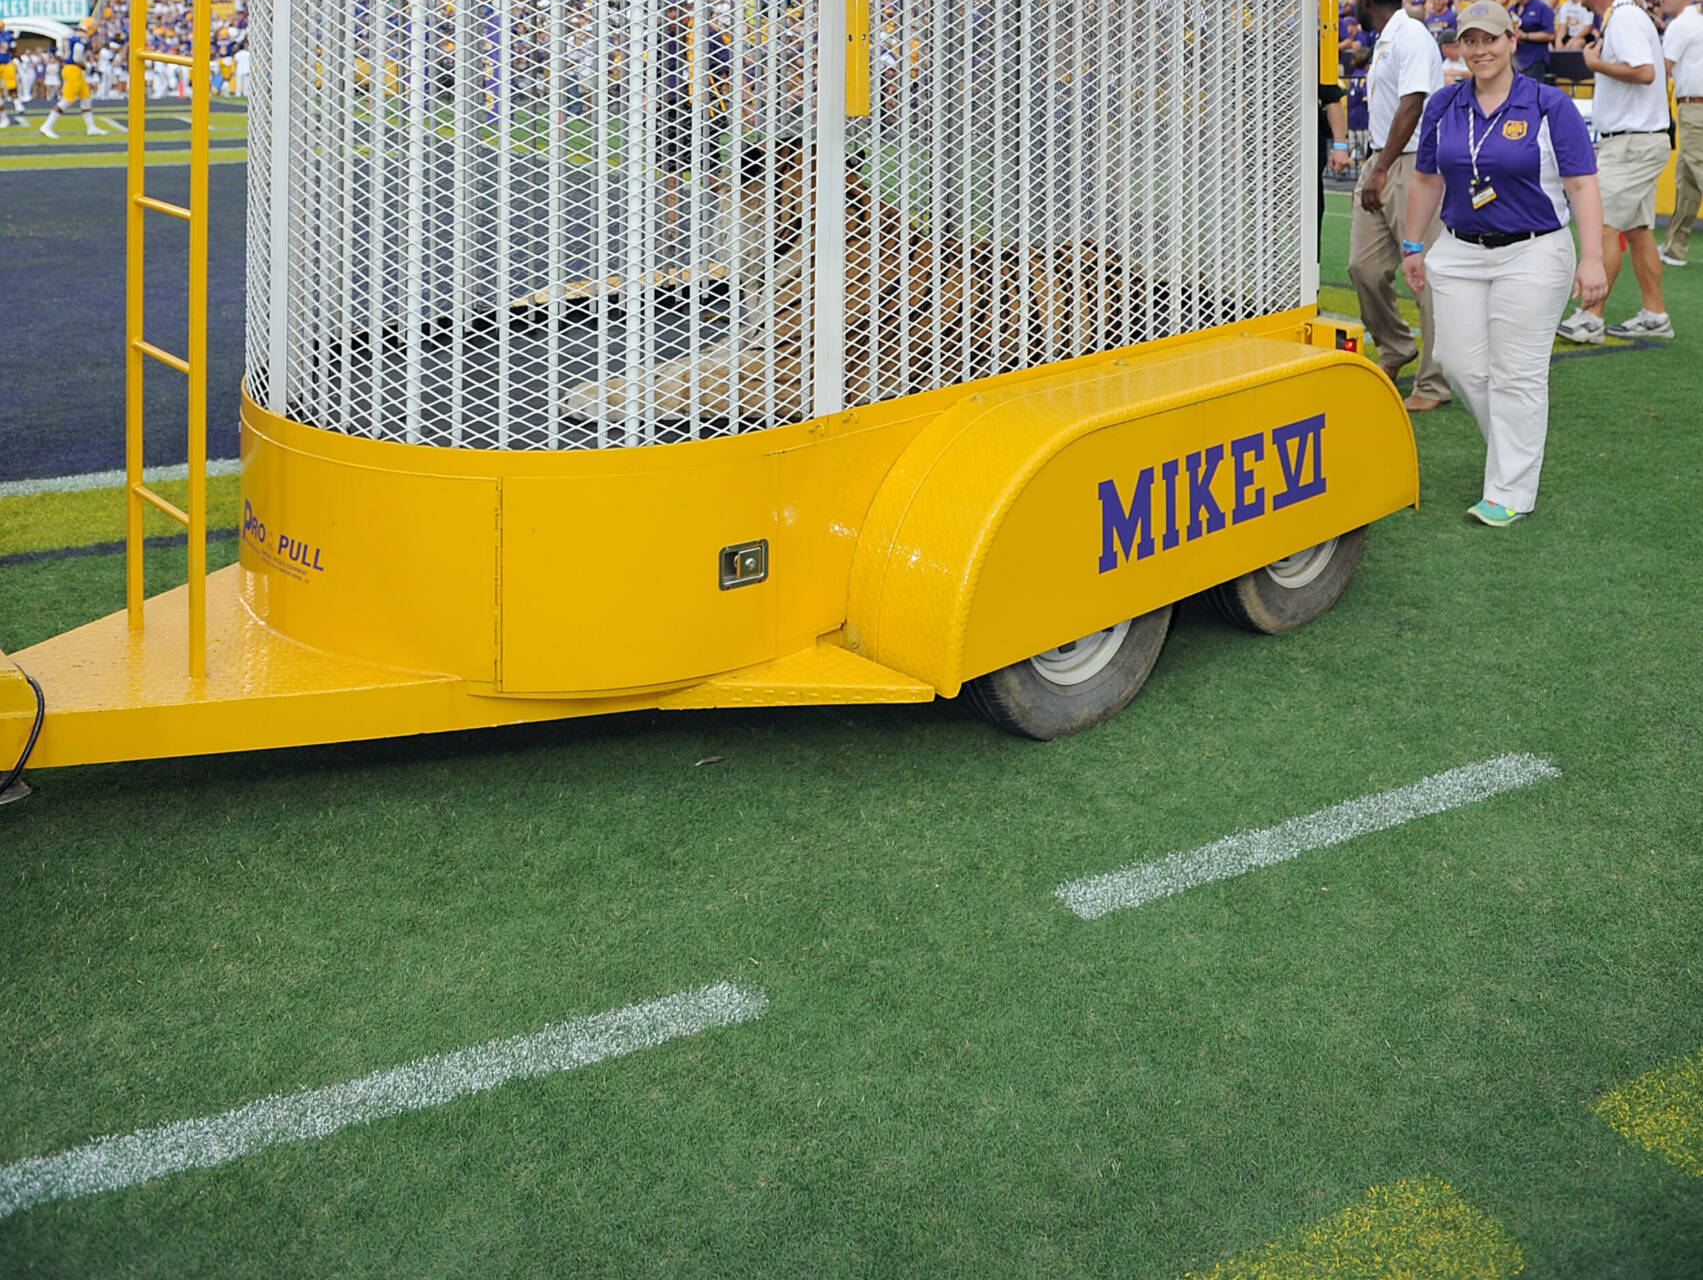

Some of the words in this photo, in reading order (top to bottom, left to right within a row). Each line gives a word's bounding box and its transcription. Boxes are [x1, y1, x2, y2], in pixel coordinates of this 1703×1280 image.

[1098, 432, 1266, 575] MIKE
[1272, 413, 1327, 511] VI
[278, 534, 324, 572] PULL
